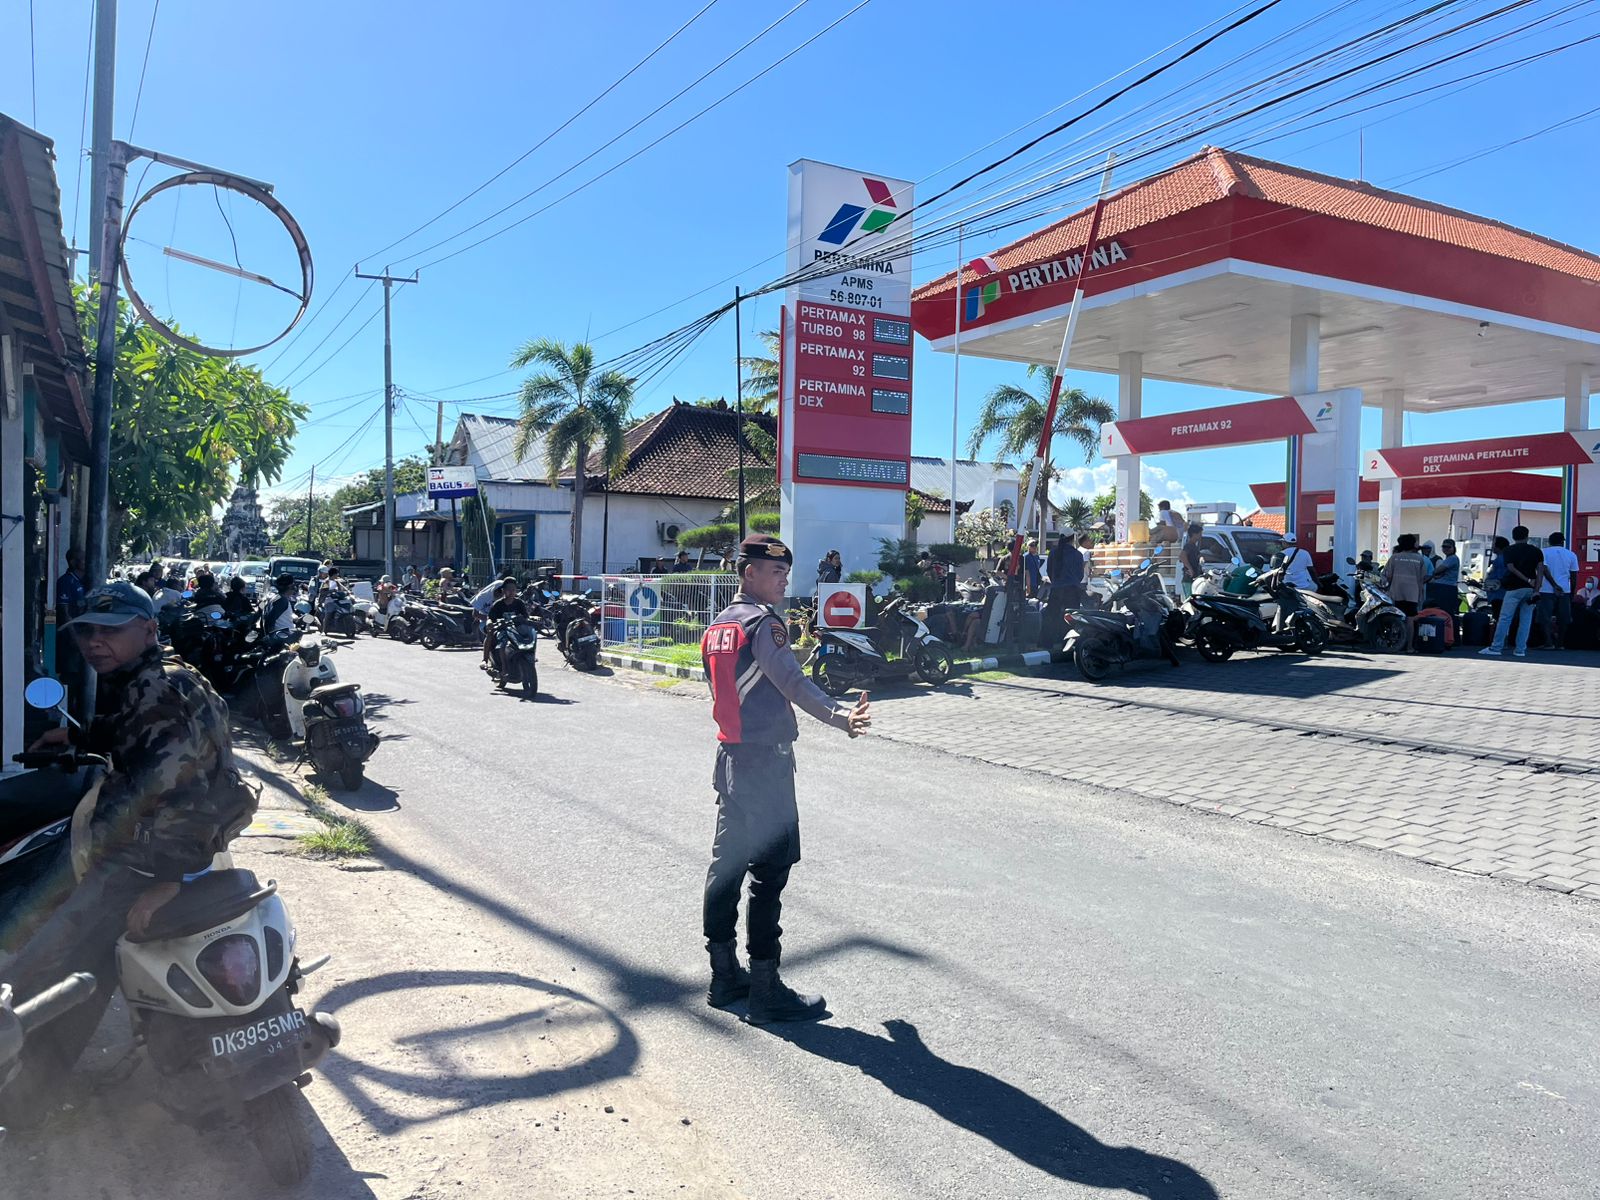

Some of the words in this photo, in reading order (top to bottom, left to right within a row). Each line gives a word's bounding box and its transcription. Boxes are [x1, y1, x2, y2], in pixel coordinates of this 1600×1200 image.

[1007, 241, 1128, 294] PERTAMNA
[840, 275, 874, 290] APMS
[801, 305, 866, 326] PERTAMAX
[801, 321, 843, 338] TURBO
[852, 329, 866, 341] 98
[800, 342, 865, 361] PERTAMAX
[852, 365, 866, 377] 92
[799, 379, 866, 397] PERTAMINA
[799, 394, 824, 408] DEX
[1171, 421, 1219, 436] PERTAMAX
[1220, 419, 1232, 430] 92
[1107, 434, 1113, 446] 1
[1423, 452, 1475, 464] PERTAMINA
[1476, 447, 1529, 460] PERTALITE
[1370, 460, 1378, 470] 2
[1423, 464, 1441, 473] DEX
[429, 480, 463, 490] BAGUS
[203, 925, 232, 940] HONDA
